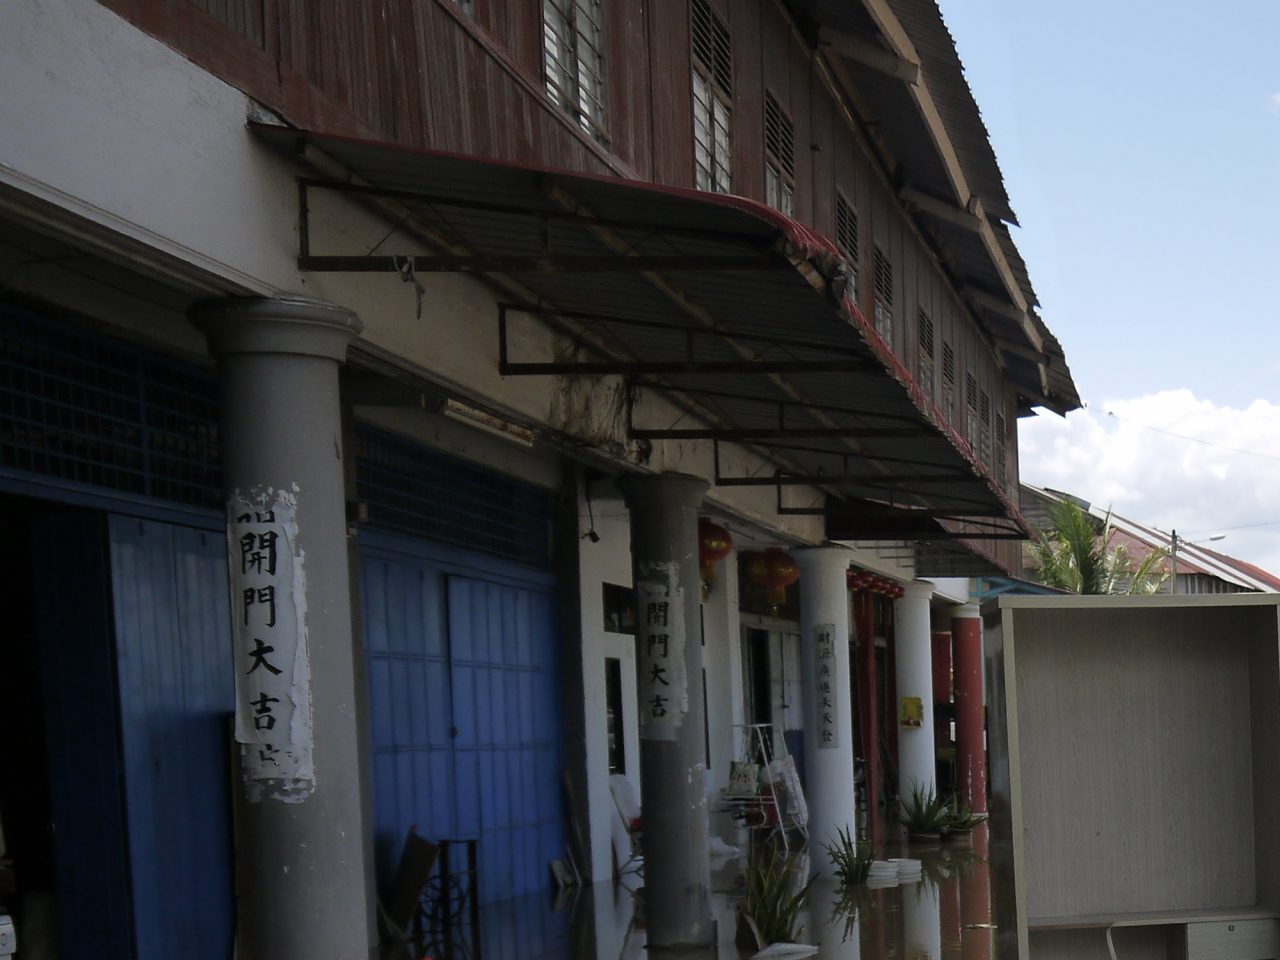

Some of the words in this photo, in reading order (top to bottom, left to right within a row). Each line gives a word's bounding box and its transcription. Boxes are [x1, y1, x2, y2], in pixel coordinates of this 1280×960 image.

[238, 510, 283, 761] 開門大吉
[646, 584, 670, 718] 開門大吉
